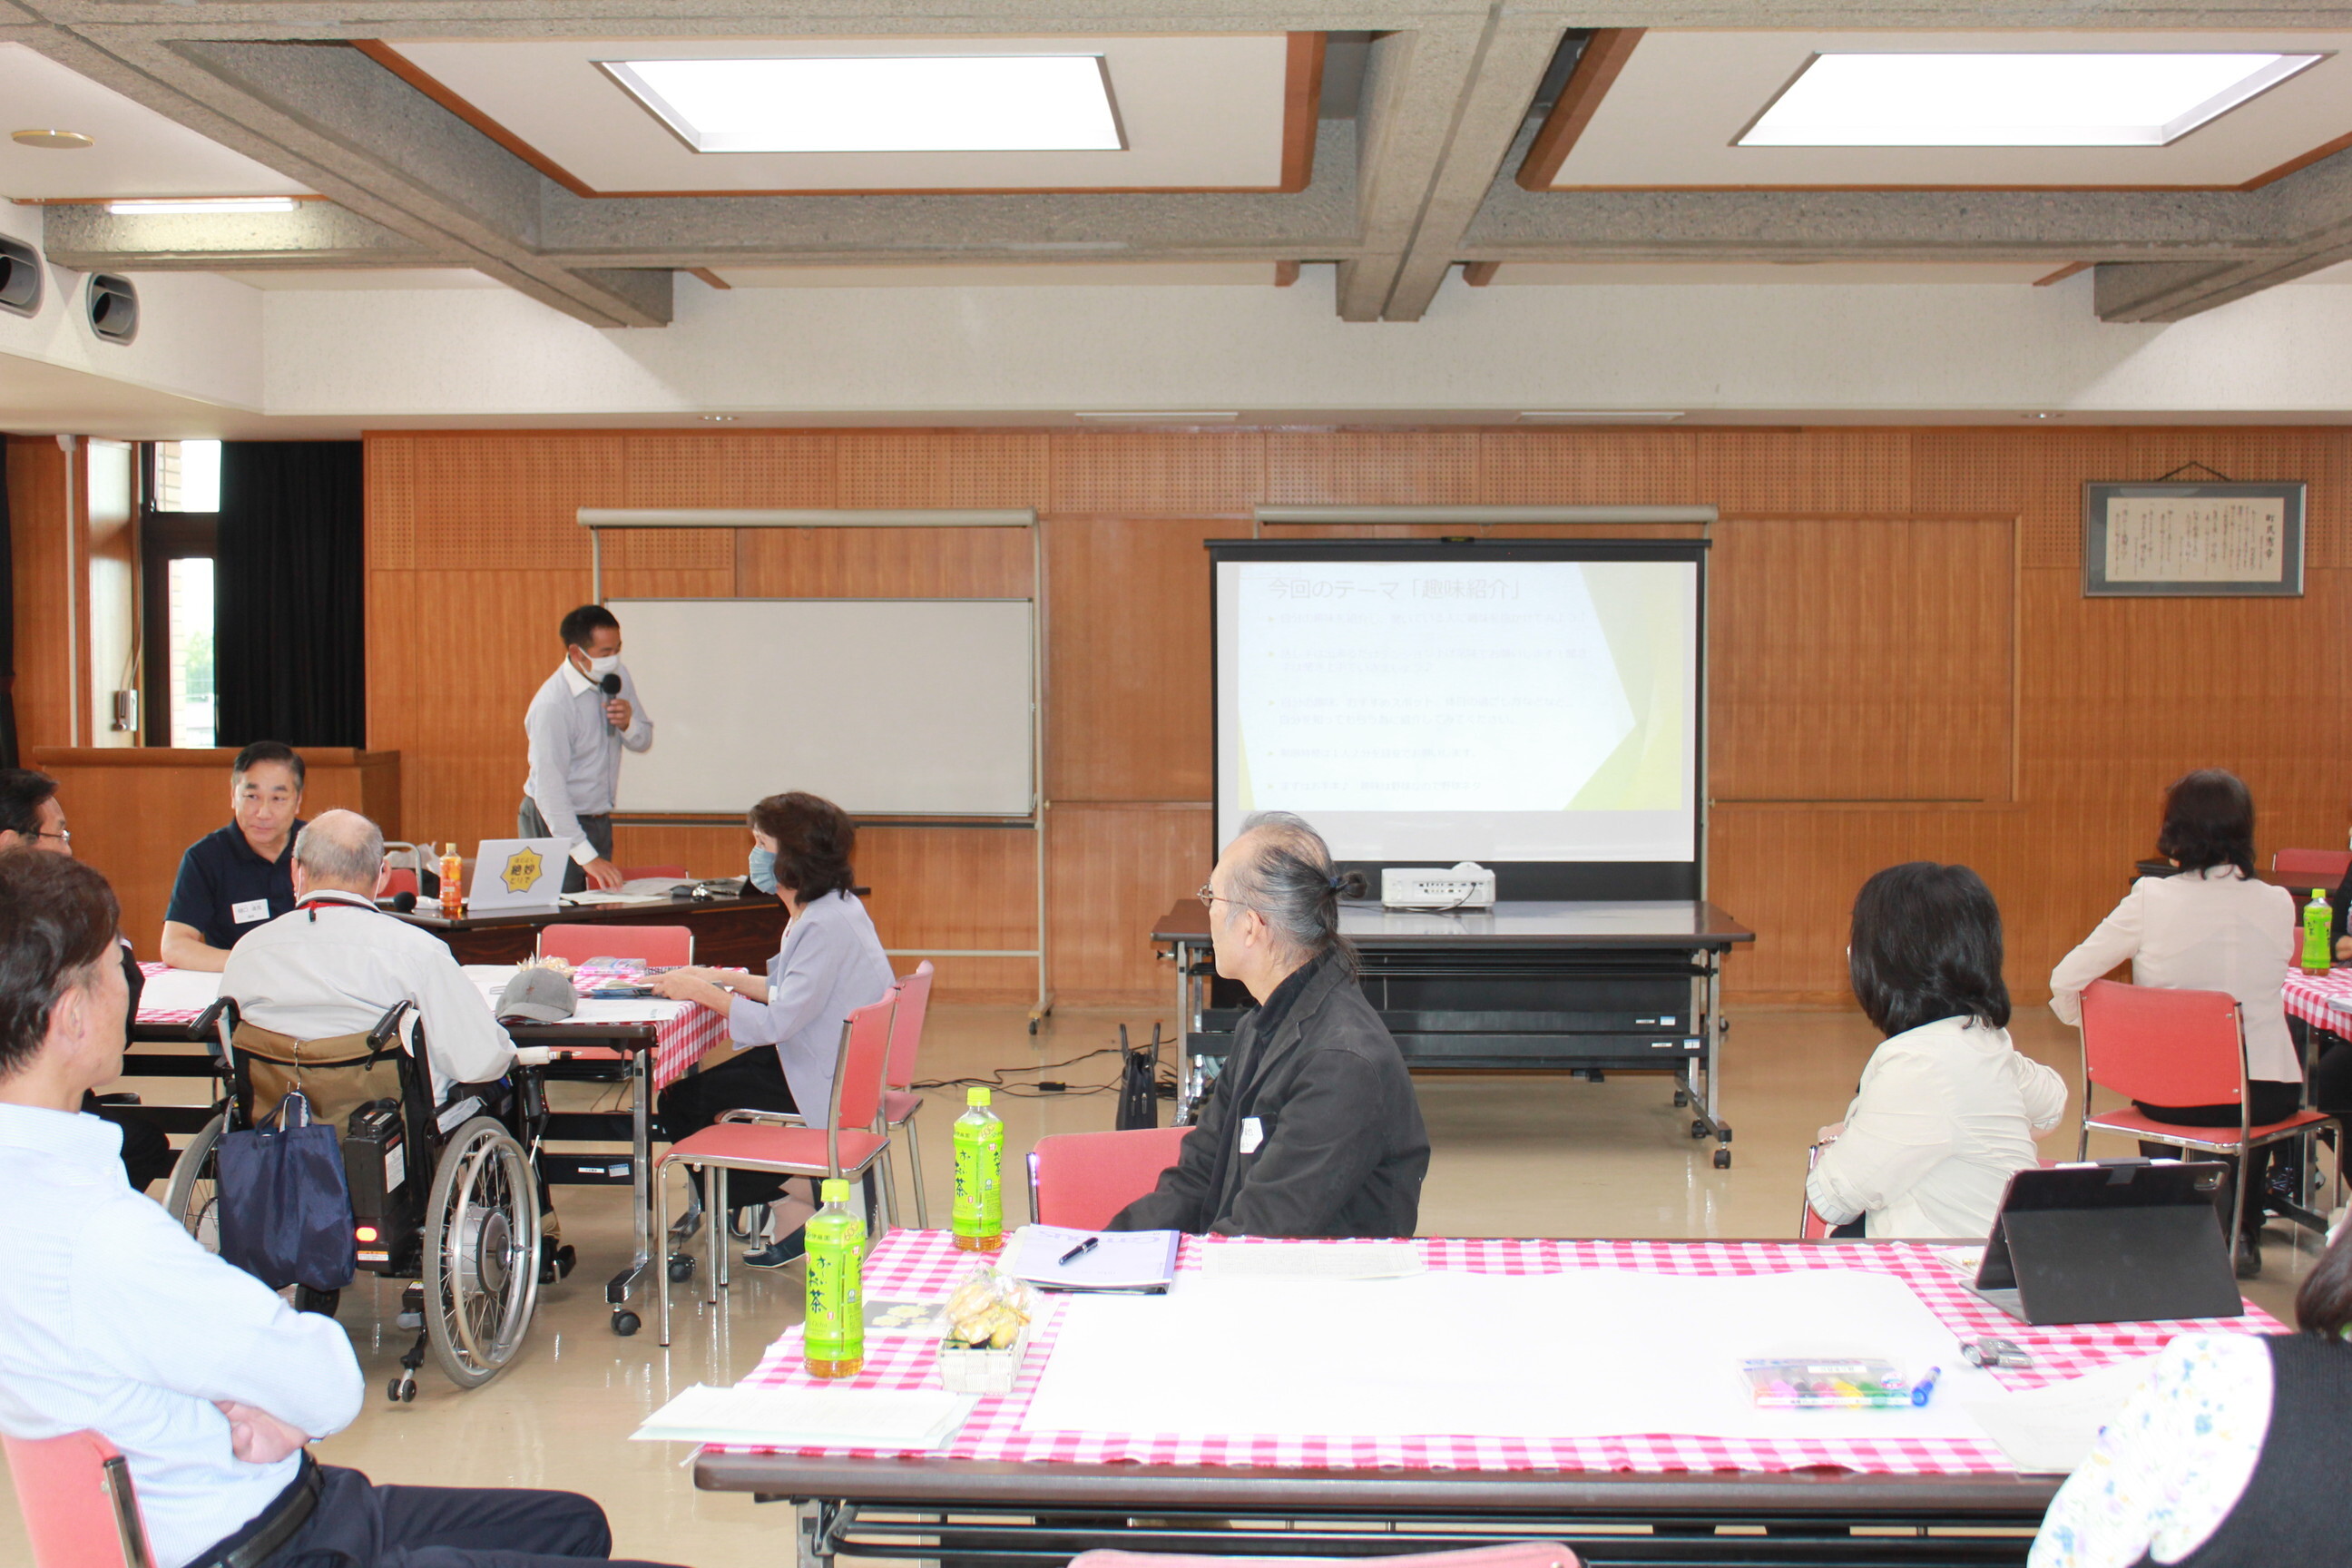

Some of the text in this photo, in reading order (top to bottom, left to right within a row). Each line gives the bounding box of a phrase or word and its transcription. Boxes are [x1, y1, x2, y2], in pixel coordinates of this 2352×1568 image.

[1268, 577, 1521, 600] 今回のテーマ「趣味紹介」
[510, 863, 535, 876] 絶妙
